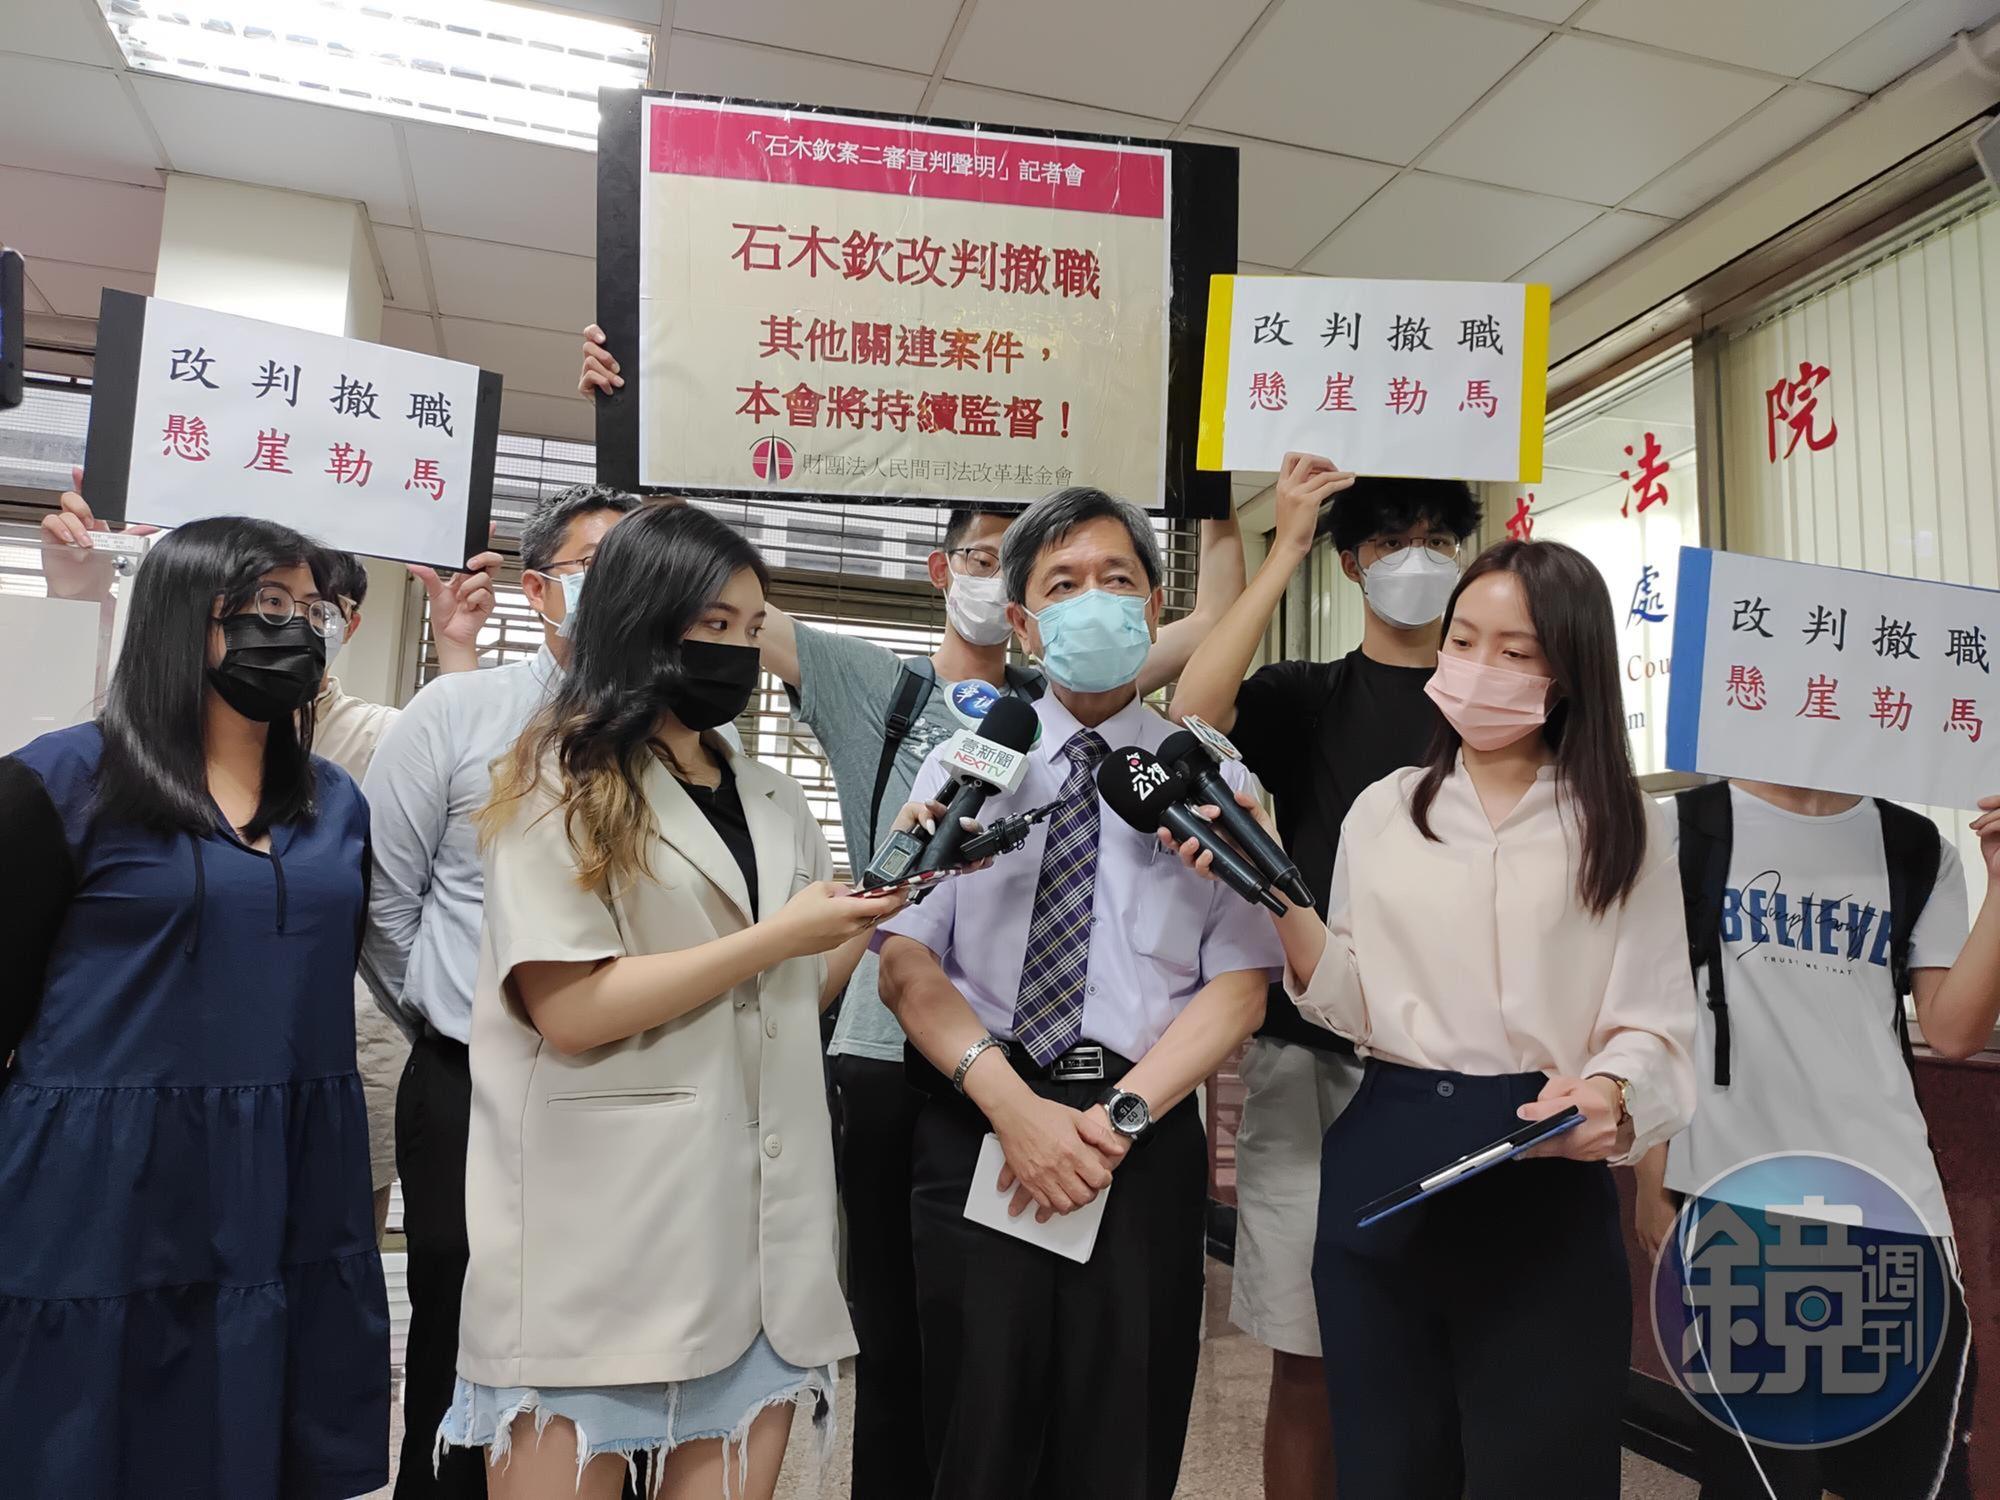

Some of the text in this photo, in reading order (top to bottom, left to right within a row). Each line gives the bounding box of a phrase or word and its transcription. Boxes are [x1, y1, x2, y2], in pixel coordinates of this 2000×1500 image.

[731, 222, 1101, 300] 石木欽改判撤職
[1253, 311, 1504, 355] 改判撤職
[169, 346, 454, 438] 改判撤職
[1249, 371, 1499, 418] 懸崖勒馬
[161, 413, 447, 502] 懸崖勒馬
[802, 453, 1074, 487] 財團法人民間司法改革基金會
[1732, 597, 1990, 674] 改判撤職
[1626, 654, 1671, 683] Cou
[1725, 664, 1984, 743] 懸崖勒馬
[1131, 761, 1171, 801] 公視
